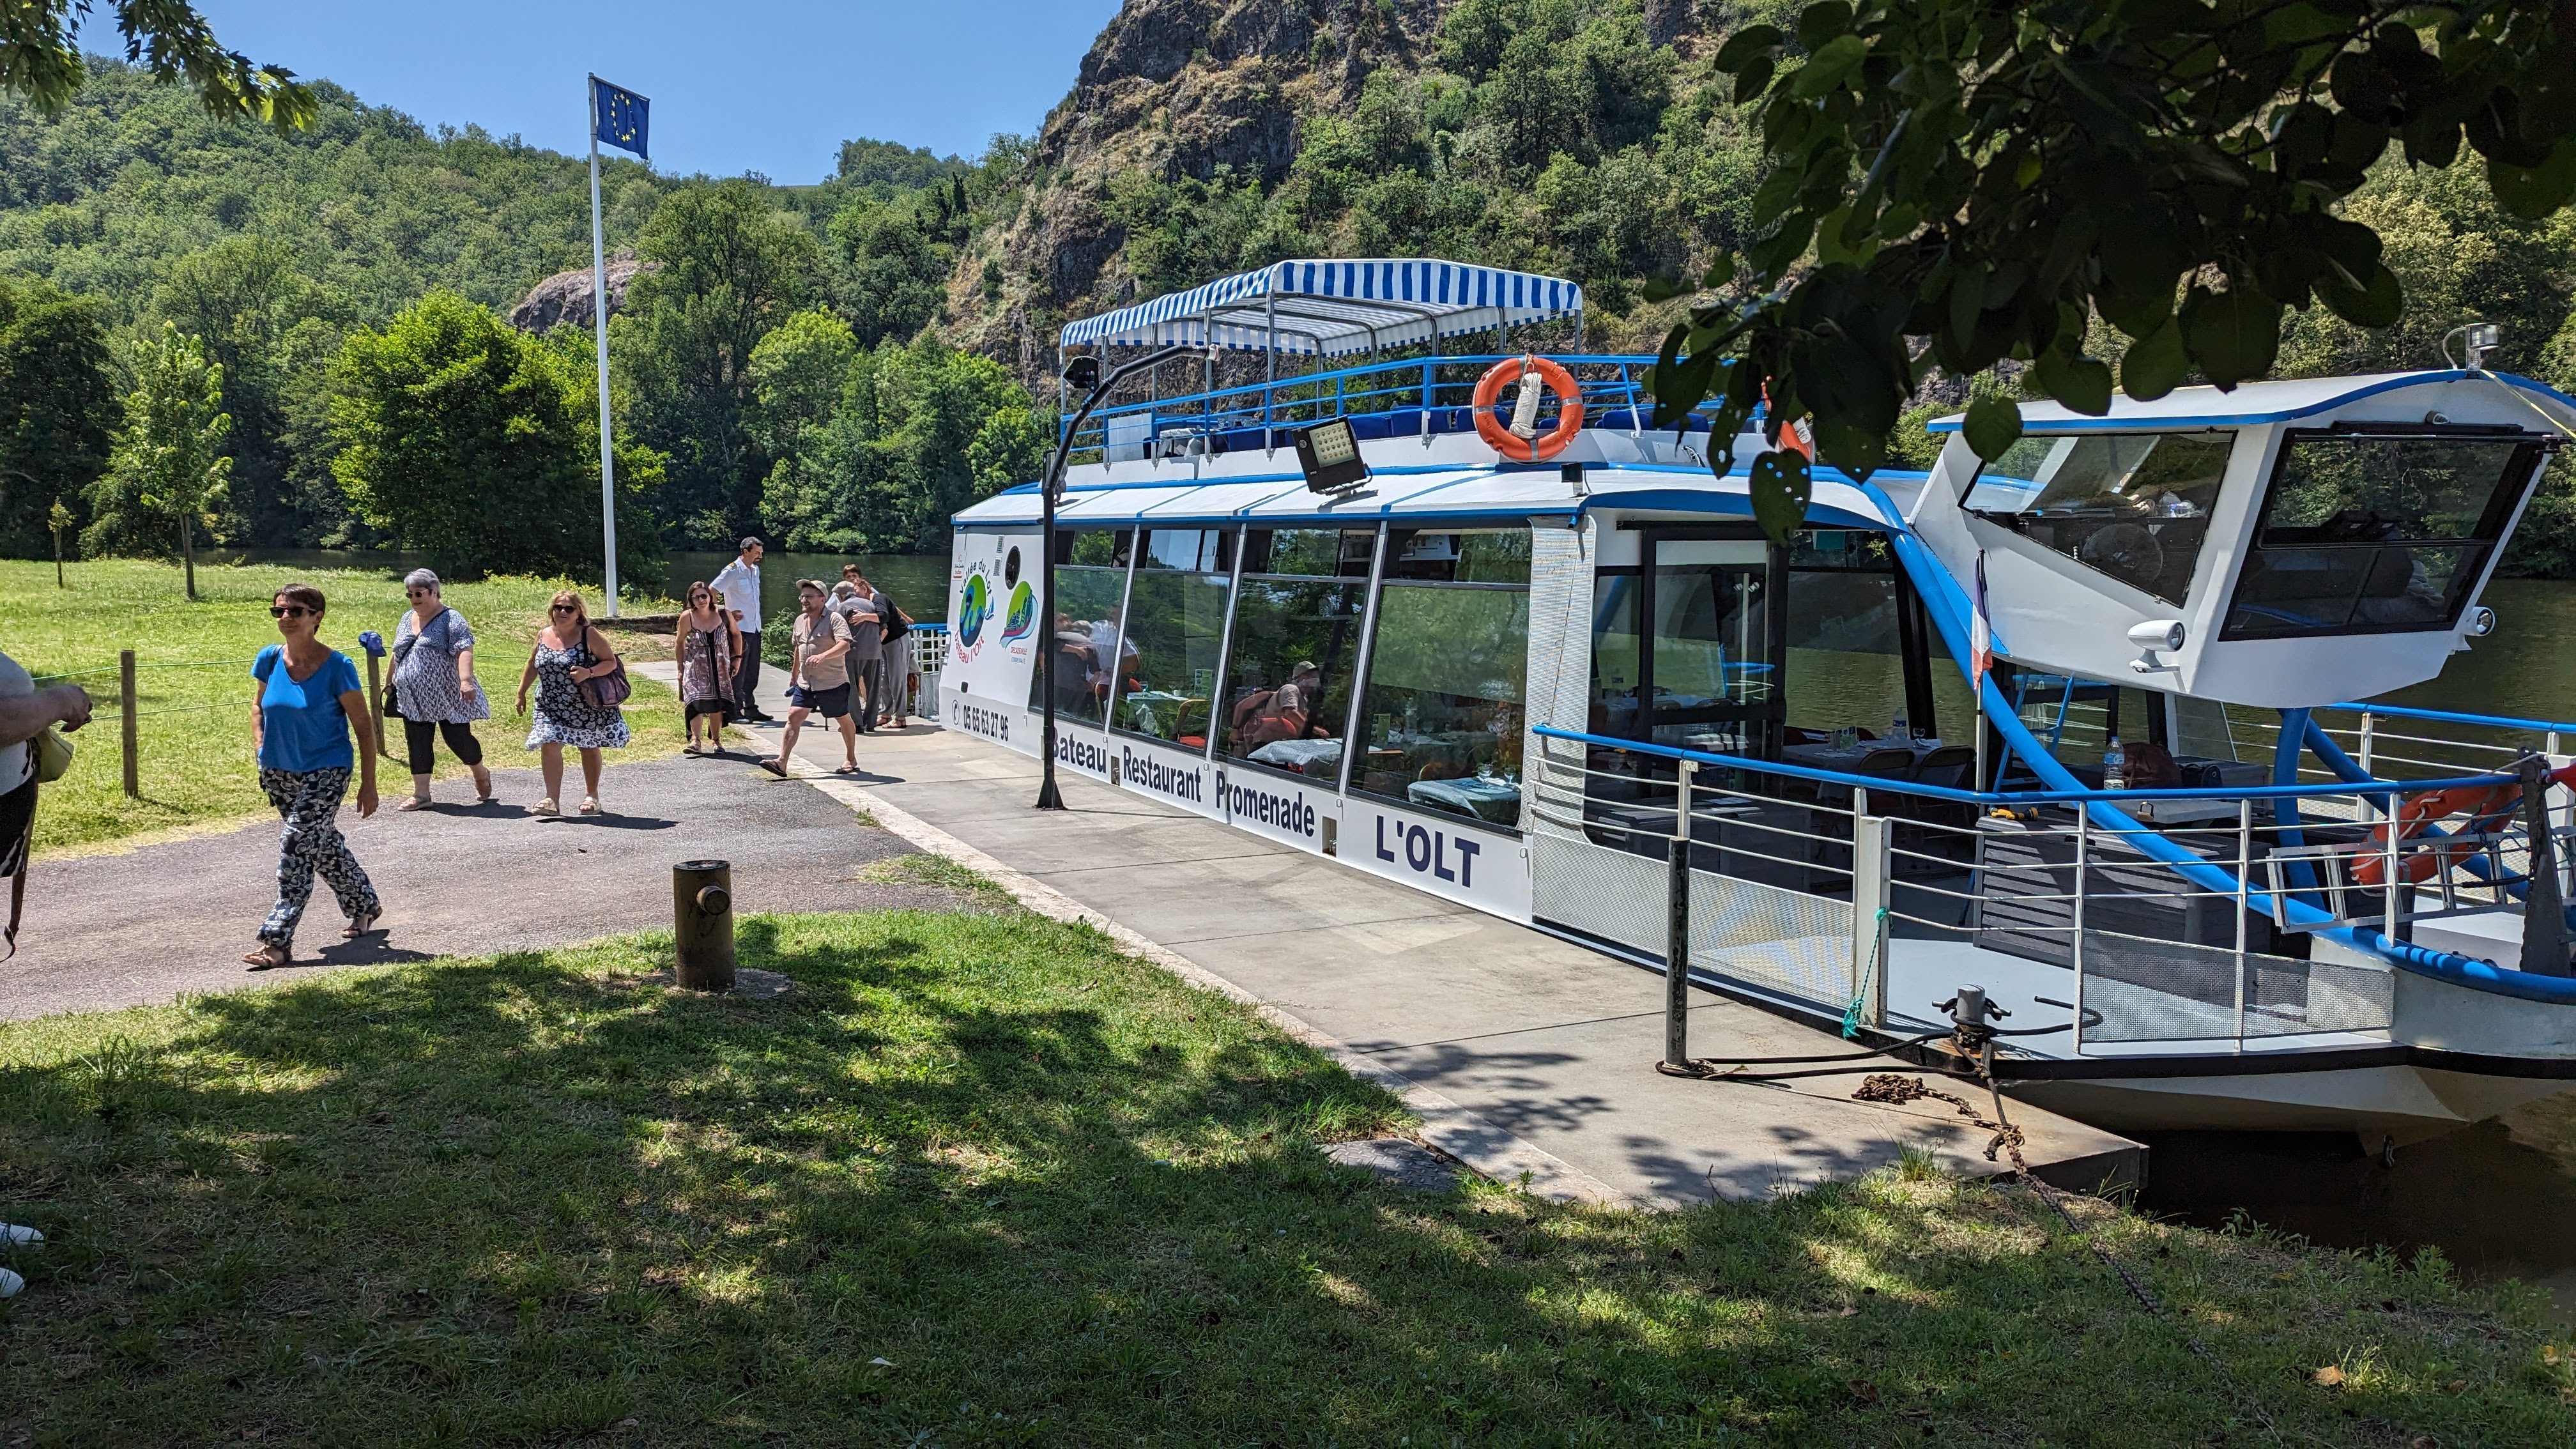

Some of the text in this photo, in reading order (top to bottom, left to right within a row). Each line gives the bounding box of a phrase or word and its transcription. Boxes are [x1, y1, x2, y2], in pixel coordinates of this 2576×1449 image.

[978, 558, 986, 573] du
[963, 704, 1009, 742] 05 65 63 27 96
[1123, 744, 1201, 803] Restaurant
[1216, 769, 1315, 838] Promenade
[1376, 815, 1480, 889] L'OLT
